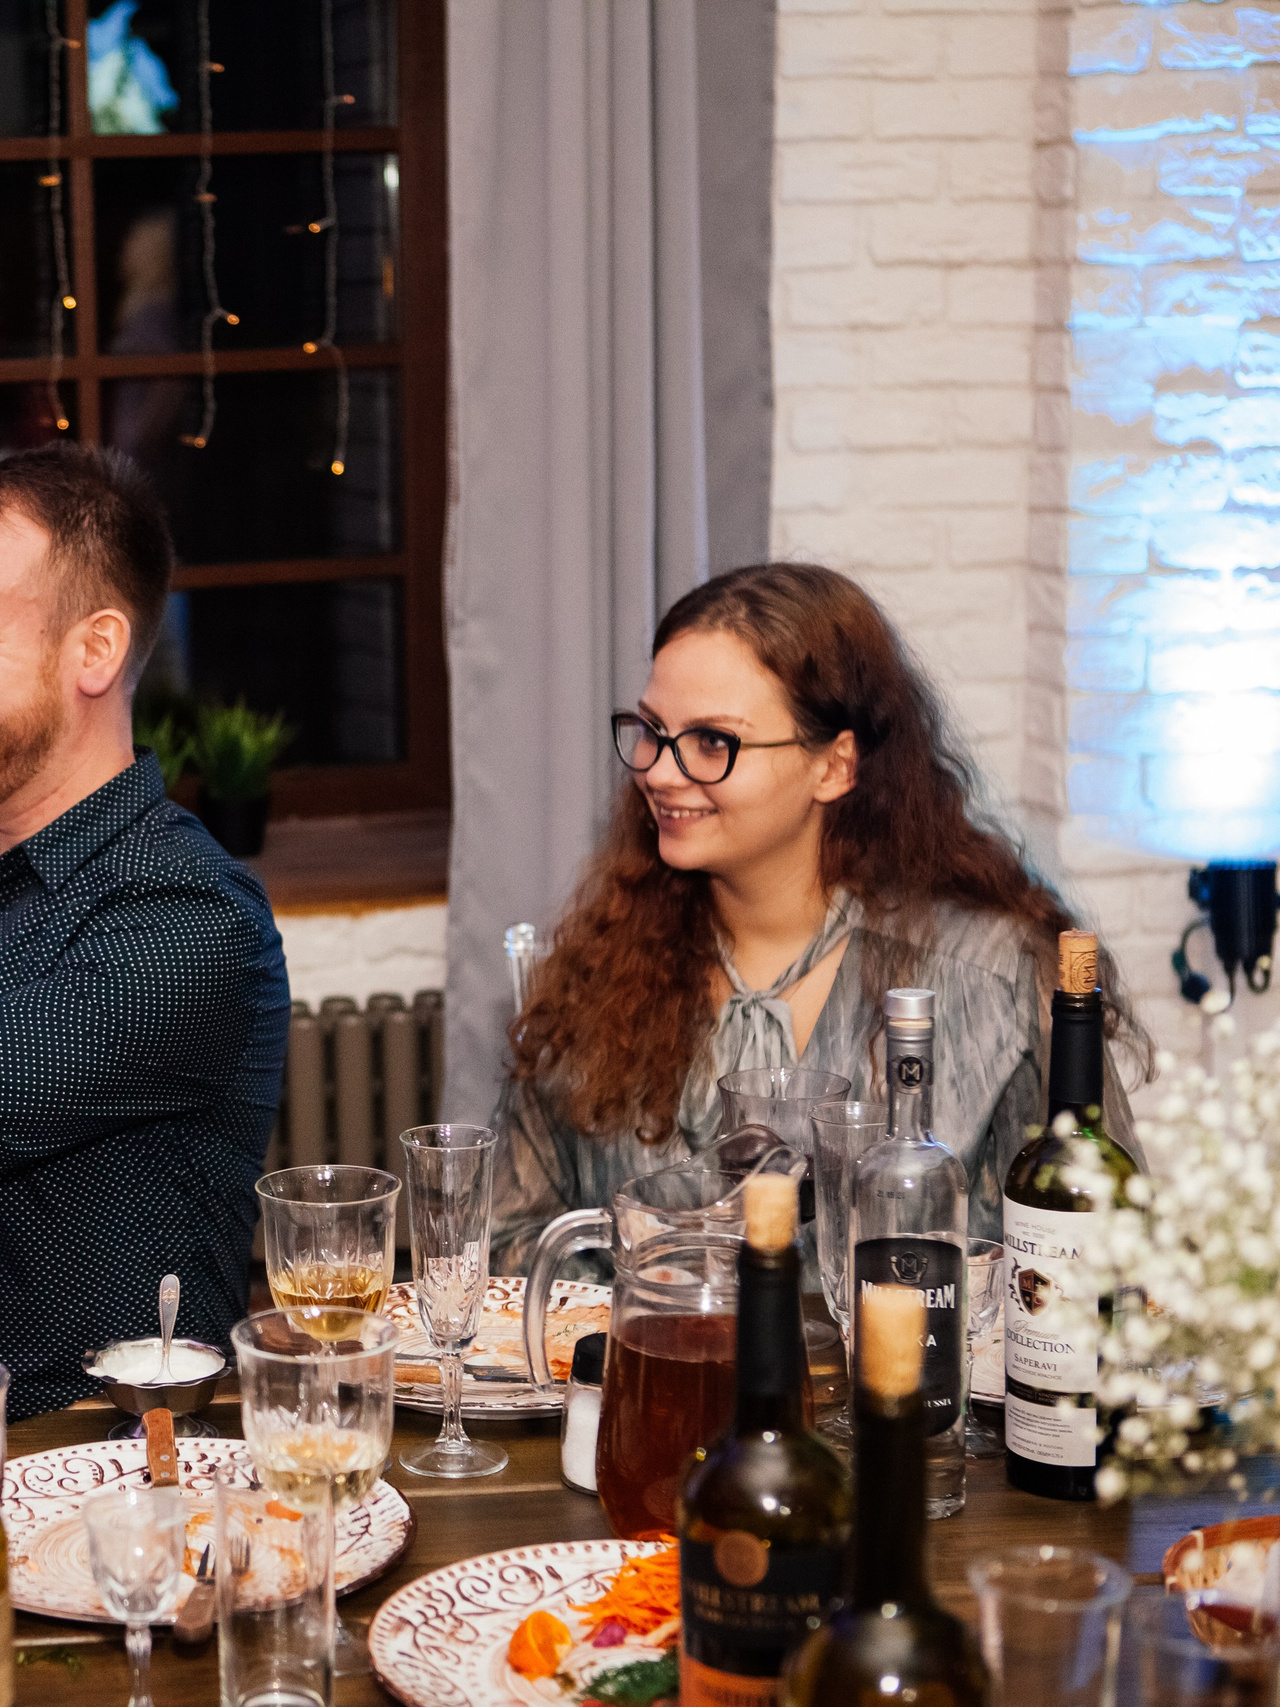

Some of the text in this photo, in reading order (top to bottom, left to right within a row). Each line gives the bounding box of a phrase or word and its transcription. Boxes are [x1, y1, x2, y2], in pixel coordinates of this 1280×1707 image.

[902, 1062, 920, 1081] M
[1031, 1223, 1057, 1235] HOUSE
[861, 1279, 956, 1309] MIREAM
[1013, 1319, 1060, 1340] Premium
[1006, 1327, 1076, 1354] COLLECTION
[1014, 1353, 1057, 1372] SAPERAVI
